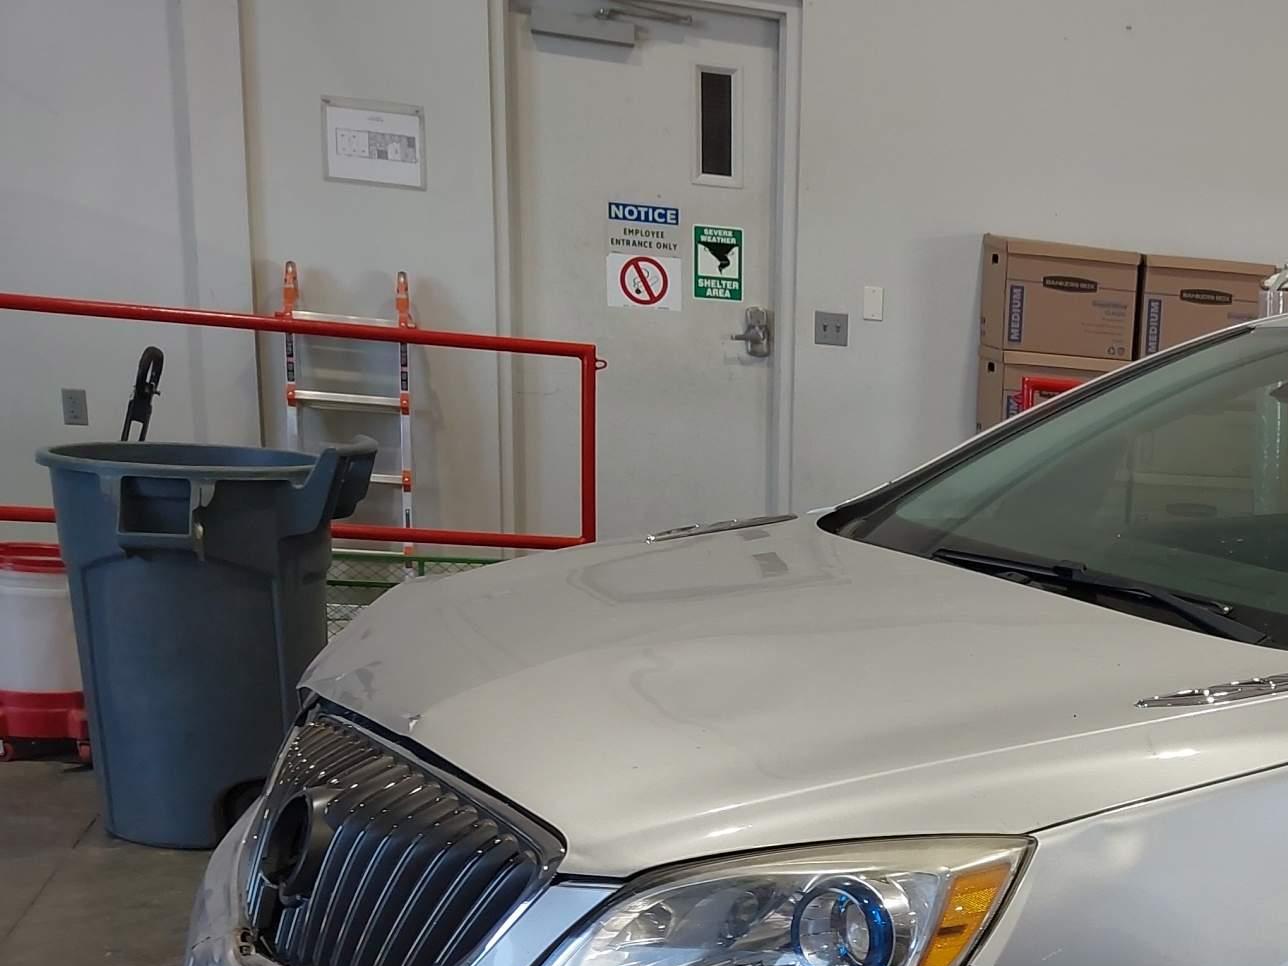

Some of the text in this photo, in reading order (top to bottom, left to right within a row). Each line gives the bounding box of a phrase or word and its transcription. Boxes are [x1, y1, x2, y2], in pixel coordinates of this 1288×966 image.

[610, 204, 677, 224] NOTICE
[623, 227, 665, 239] EMPLOYEE
[703, 228, 733, 237] SEVERE
[610, 237, 678, 251] ENTRANCE ONLY
[700, 235, 737, 244] WEATHER
[698, 278, 739, 290] SHELTER
[705, 288, 731, 298] AREA
[1010, 288, 1022, 340] MEDIUM
[1148, 301, 1160, 353] MEDIUM
